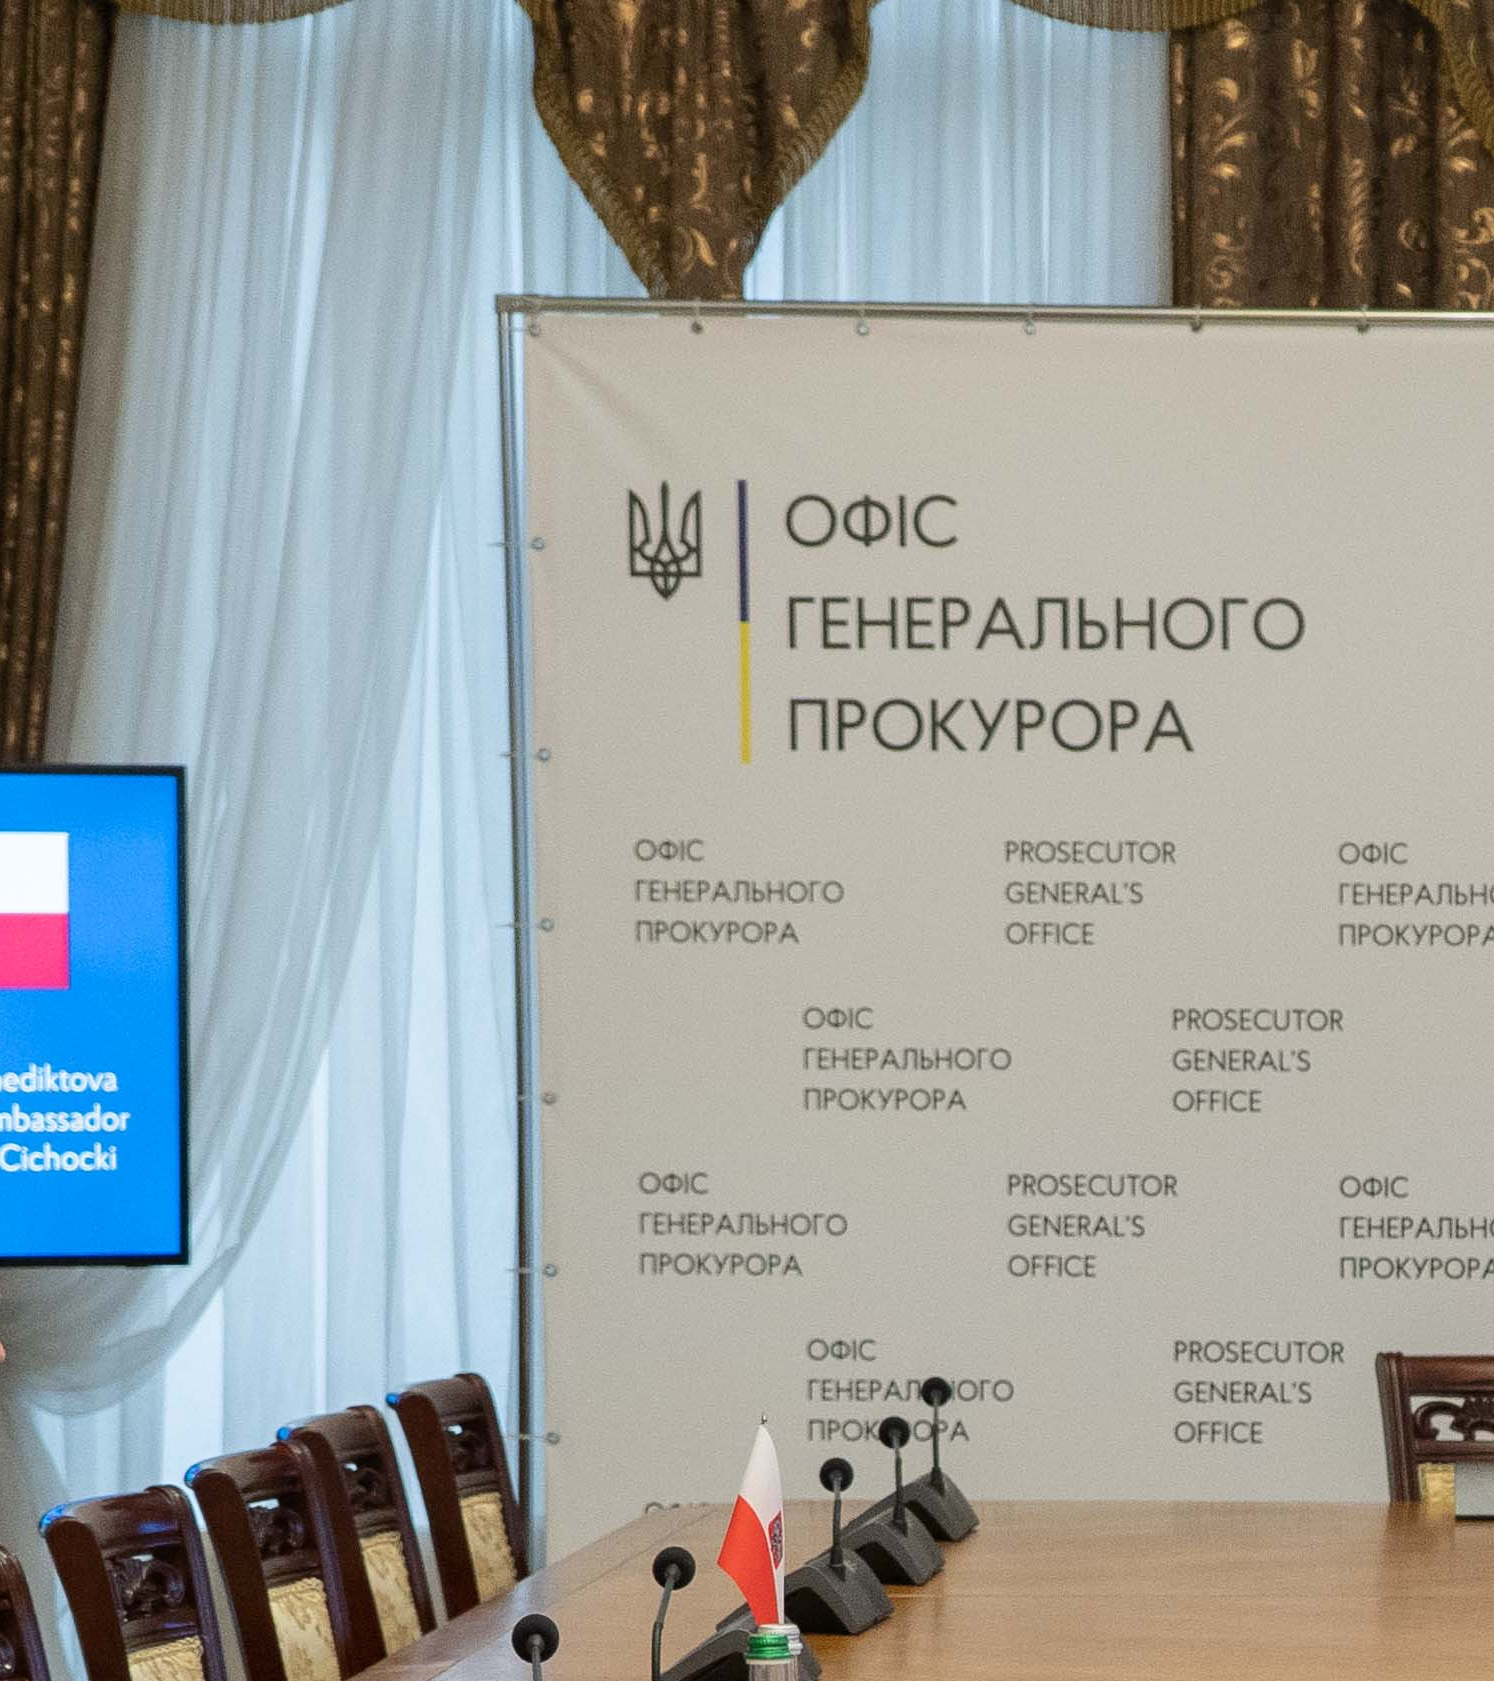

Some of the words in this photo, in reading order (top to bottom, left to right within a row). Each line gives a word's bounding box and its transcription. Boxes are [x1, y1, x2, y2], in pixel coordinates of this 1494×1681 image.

[783, 493, 959, 550] ОФІС
[786, 595, 1307, 653] ГЕНЕРАЛЬНОГО
[788, 697, 1195, 754] ПРОКУРОРА
[633, 838, 705, 863] ОФІС
[1004, 839, 1177, 865] PROSECUTOR
[1337, 841, 1408, 866] ОФІС
[634, 878, 845, 905] ГЕНЕРАЛЬНОГО
[1004, 880, 1144, 906] GENERAL'S
[634, 919, 800, 945] ПРОКУРОРА
[1004, 921, 1095, 946] OFFICE
[801, 1005, 874, 1031] ОФІС
[1171, 1007, 1344, 1033] PROSECUTOR
[802, 1046, 1013, 1072] ГЕНЕРАЛЬНОГО
[1171, 1048, 1312, 1073] GENERAL'S
[803, 1087, 968, 1112] ПРОКУРОРА
[1171, 1088, 1262, 1114] OFFICE
[637, 1171, 709, 1196] ОФІС
[1006, 1172, 1178, 1198] PROSECUTOR
[1338, 1174, 1409, 1200] ОФІС
[638, 1211, 849, 1237] ГЕНЕРАЛЬНОГО
[1006, 1213, 1146, 1239] GENERAL'S
[638, 1251, 804, 1277] ПРОКУРОРА
[1006, 1253, 1097, 1279] OFFICE
[805, 1337, 877, 1363] ОФІС
[1173, 1339, 1345, 1365] PROSECUTOR
[807, 1377, 1015, 1403] ГЕНЕРАЛОГО
[1172, 1379, 1313, 1405] GENERAL'S
[1173, 1420, 1263, 1445] OFFICE
